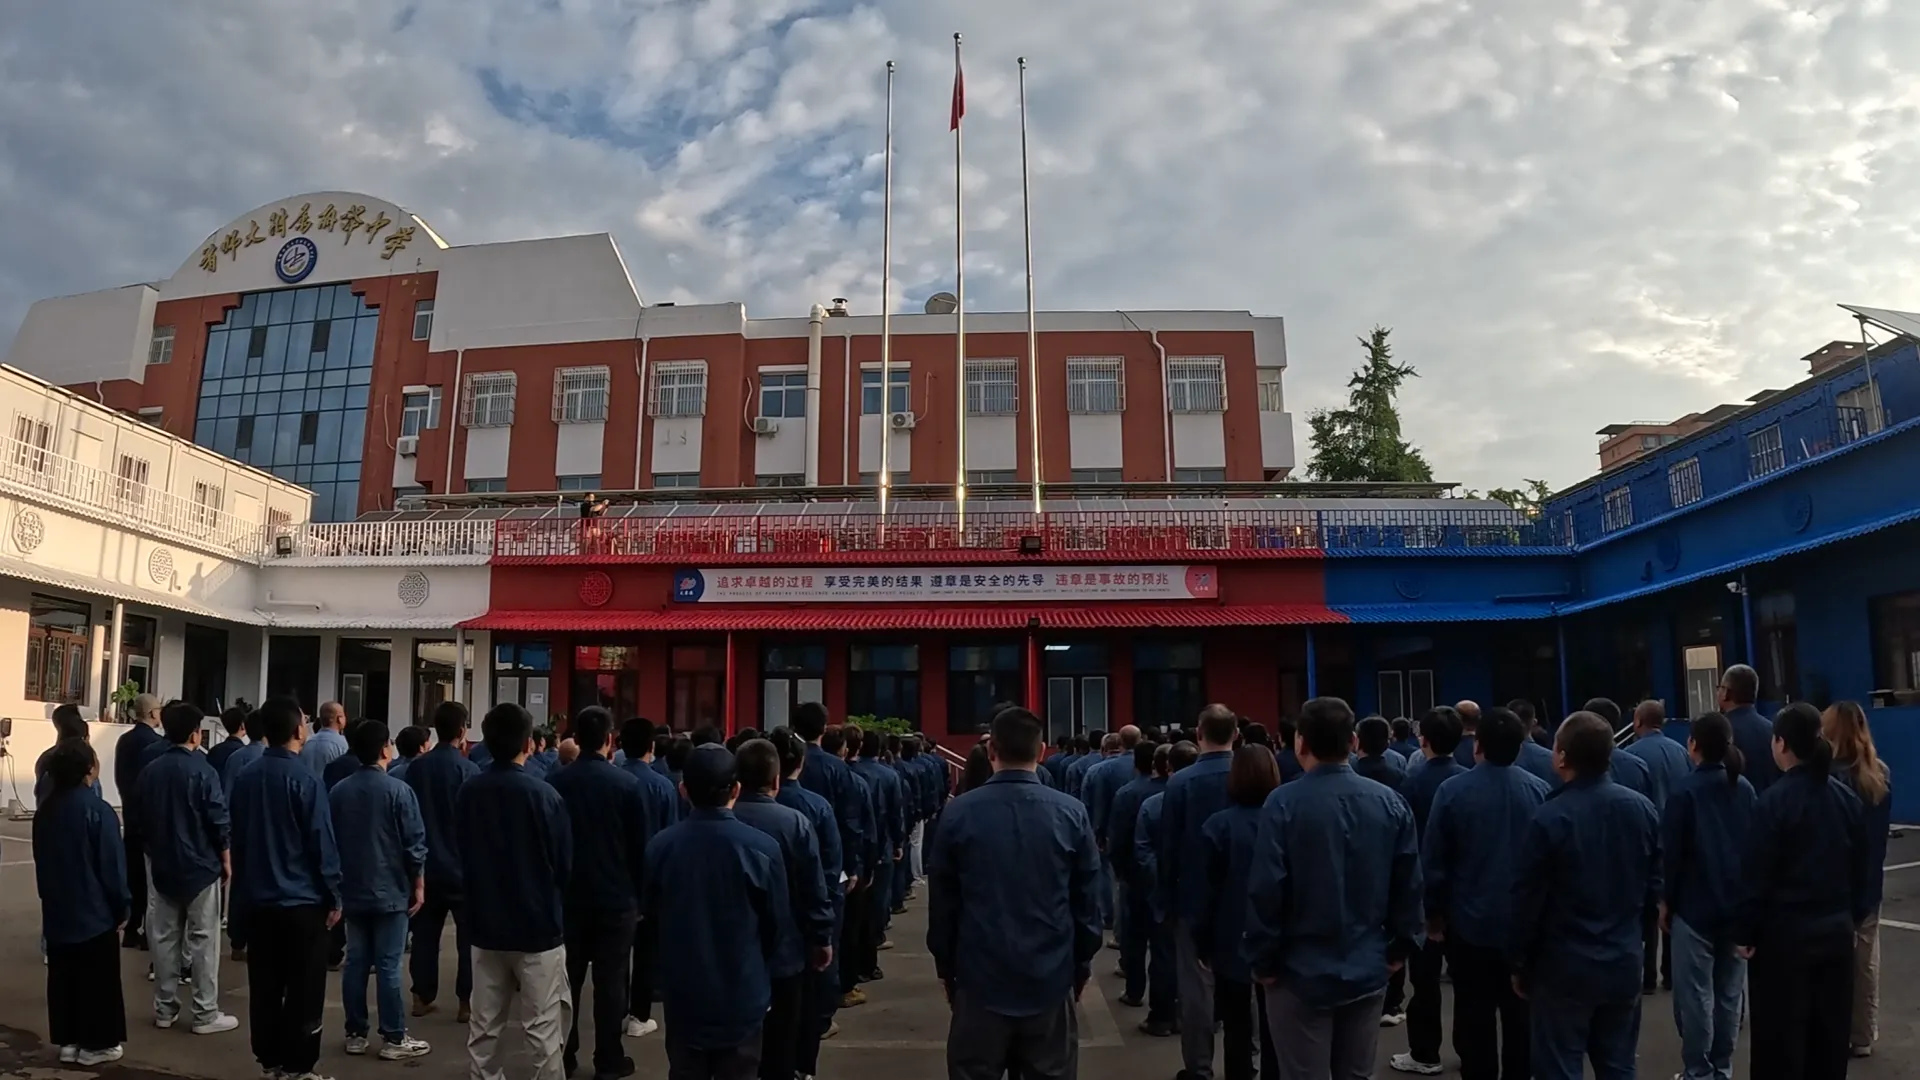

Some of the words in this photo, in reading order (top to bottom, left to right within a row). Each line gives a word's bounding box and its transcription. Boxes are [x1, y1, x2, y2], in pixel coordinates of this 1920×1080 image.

[716, 575, 814, 588] 追求卓越的过程
[824, 575, 923, 588] 享受完美的结果
[930, 574, 1045, 588] 遵章是安全的先导
[1055, 573, 1170, 586] 违章是事故的预兆
